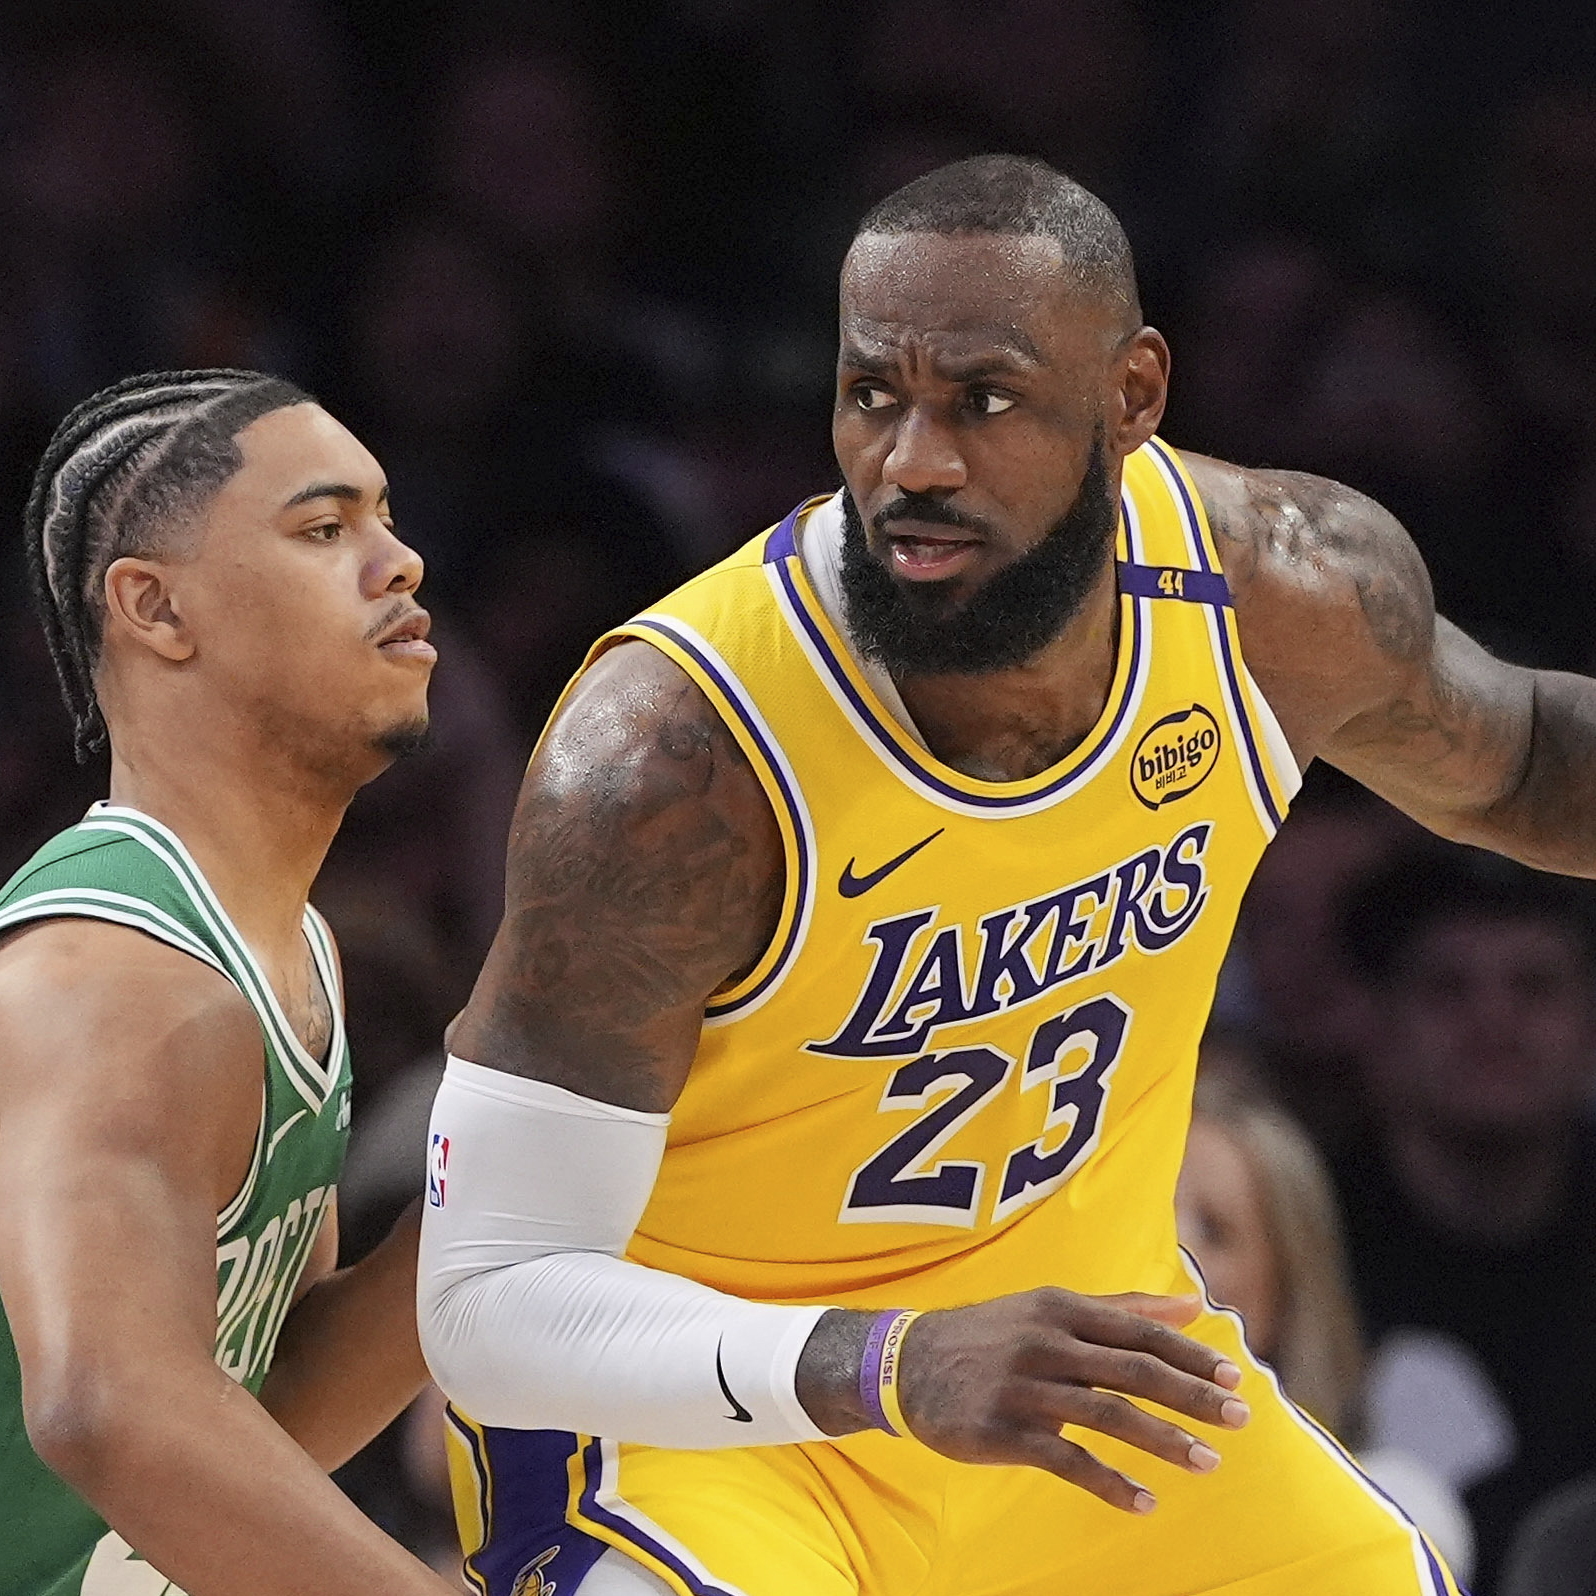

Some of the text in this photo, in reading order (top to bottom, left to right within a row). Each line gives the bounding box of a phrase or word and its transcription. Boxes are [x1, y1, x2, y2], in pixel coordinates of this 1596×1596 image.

[1158, 570, 1184, 596] 44
[1138, 728, 1215, 782] bibigo
[1155, 765, 1188, 790] 비비고
[805, 820, 1216, 1061] LAKERS
[837, 990, 1134, 1230] 23
